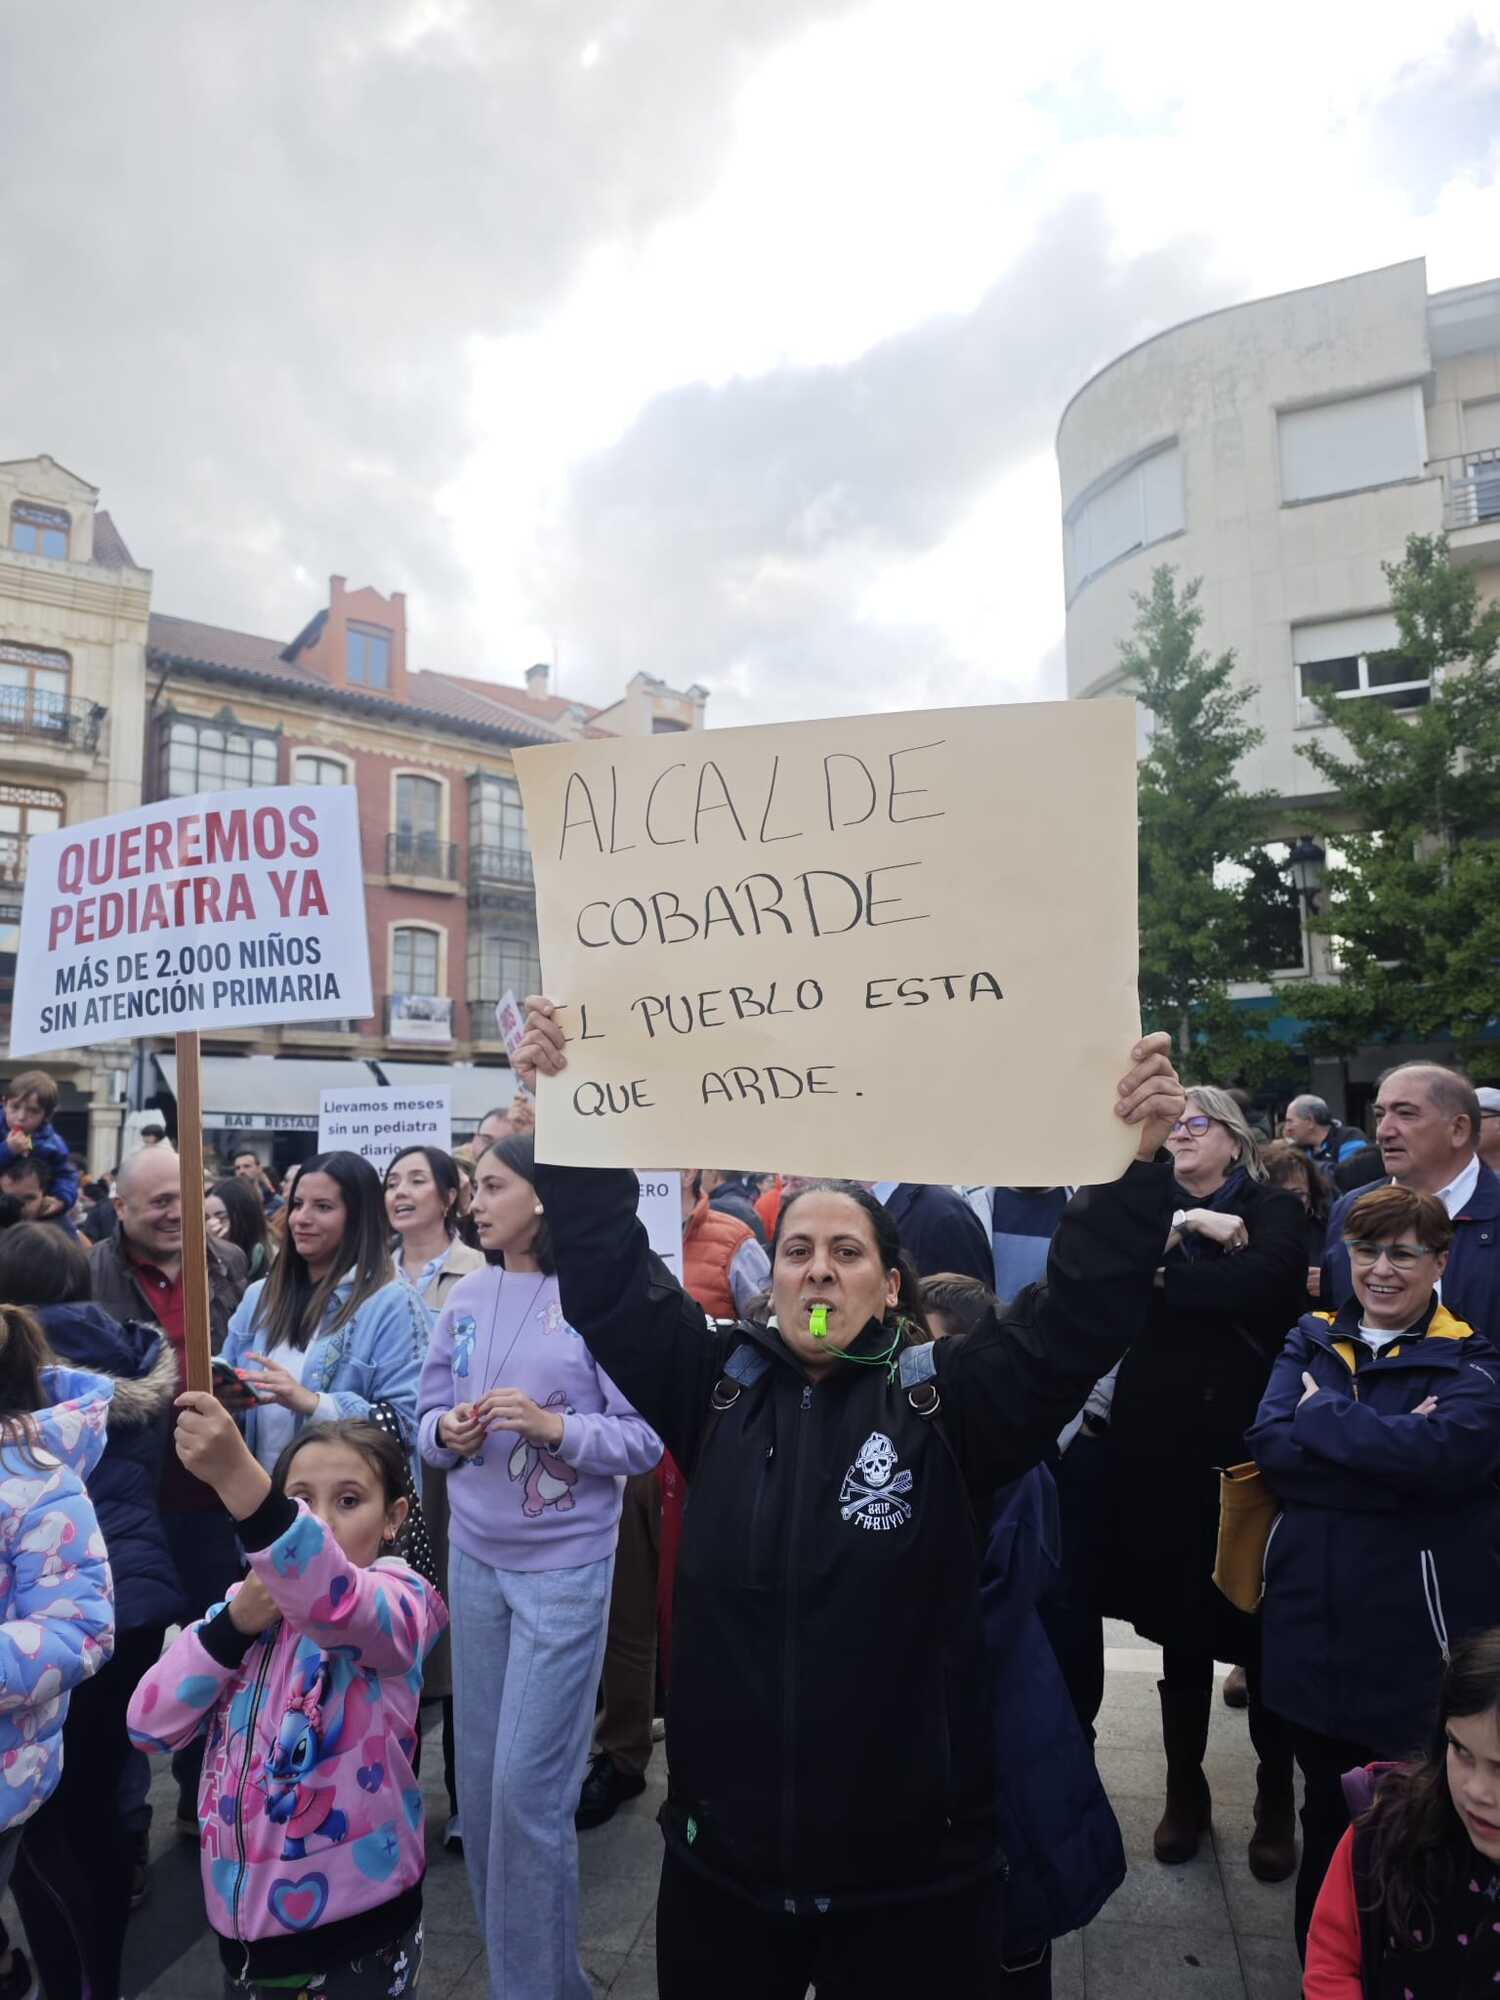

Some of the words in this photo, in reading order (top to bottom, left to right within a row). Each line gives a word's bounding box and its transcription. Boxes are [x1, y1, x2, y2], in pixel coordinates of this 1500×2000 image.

[559, 739, 946, 860] ALCALDE
[57, 805, 320, 895] QUEREMOS
[48, 872, 256, 951] PEDIATRA
[268, 869, 329, 917] YA
[576, 862, 930, 948] COBARDE
[55, 956, 109, 996] MÁS
[117, 952, 149, 983] DE
[155, 942, 232, 978] 2.000
[240, 932, 321, 969] NIÑOS
[40, 1001, 77, 1034] SIN
[84, 980, 205, 1024] ATENCIÓN
[213, 973, 341, 1009] PRIMARIA
[631, 979, 824, 1038] PUEBLO
[865, 971, 1004, 1010] ESTA
[225, 1115, 253, 1127] BAR
[324, 1101, 388, 1114] Llevamos
[393, 1099, 444, 1111] meses
[328, 1122, 348, 1135] sin
[352, 1124, 370, 1135] un
[374, 1121, 438, 1136] pediatra
[573, 1079, 656, 1116] QUE
